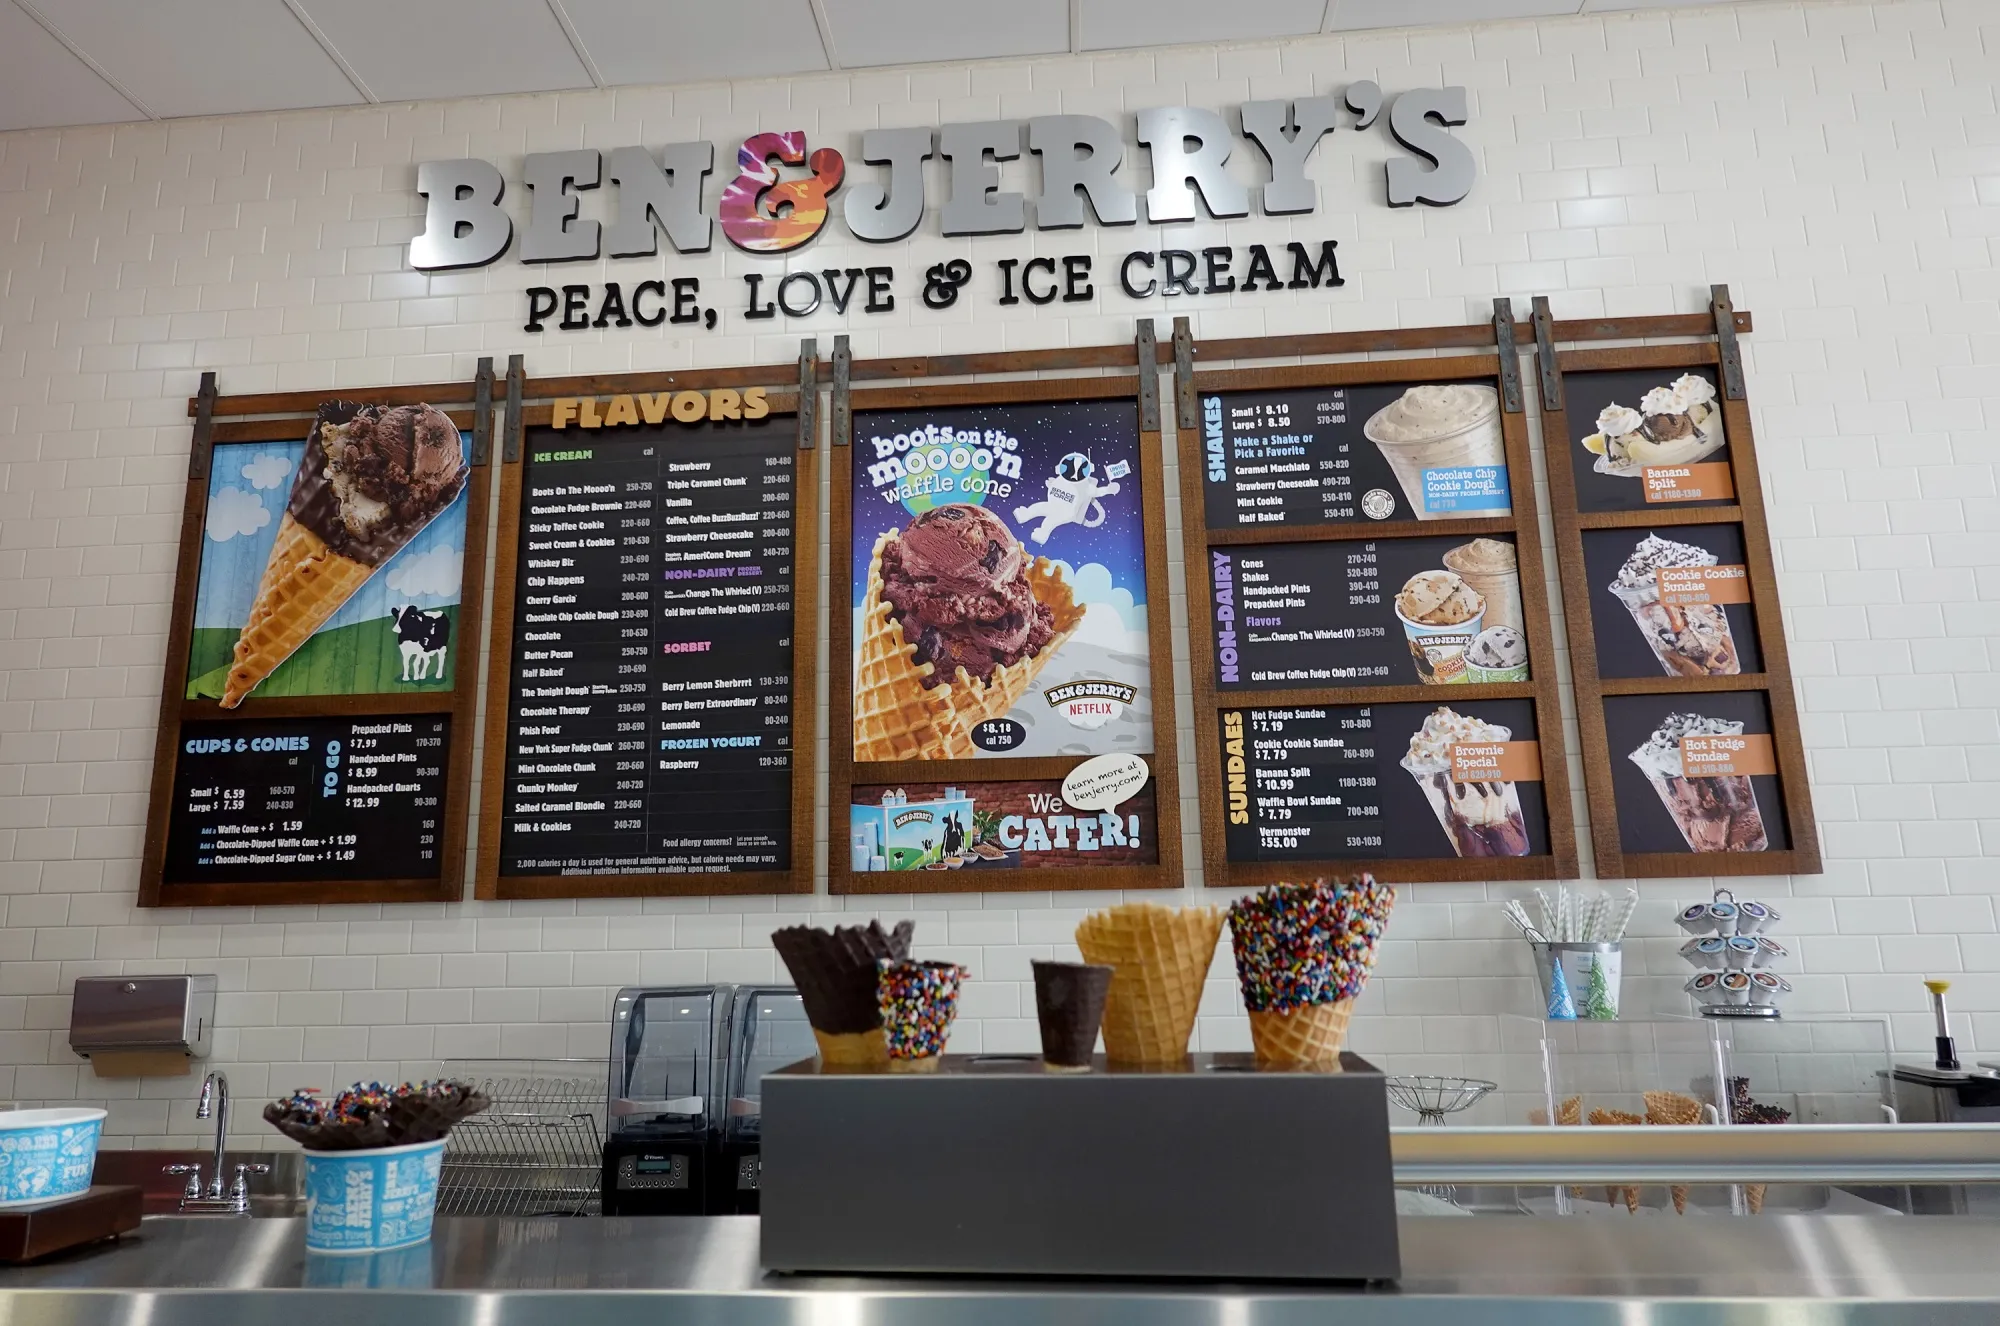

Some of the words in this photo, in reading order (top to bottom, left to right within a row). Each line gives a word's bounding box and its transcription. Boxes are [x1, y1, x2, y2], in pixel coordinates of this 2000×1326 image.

[524, 277, 717, 332] PEACE,
[744, 267, 895, 318] LOVE
[923, 258, 972, 309] &
[998, 255, 1093, 305] ICE
[1120, 240, 1345, 299] CREAM
[552, 387, 770, 429] FLAVORS
[1316, 402, 1345, 412] 410-500
[871, 423, 954, 459] boots
[956, 429, 981, 445] on
[983, 429, 1019, 451] the
[1203, 396, 1227, 483] SHAKES
[1233, 436, 1260, 447] Make
[1262, 438, 1269, 446] a
[1270, 434, 1301, 446] Shake
[1302, 434, 1313, 443] or
[534, 452, 552, 462] ICE
[553, 450, 593, 461] CREAM
[1234, 447, 1256, 459] Pick
[1257, 449, 1263, 458] a
[1265, 445, 1305, 457] Favorite
[669, 461, 711, 472] Strawberry
[867, 446, 1023, 488] moooo'n
[1319, 459, 1350, 471] 550-820
[1426, 470, 1471, 482] Chocolate
[1473, 468, 1497, 481] Chip
[1647, 468, 1691, 479] Banana
[532, 487, 554, 497] Boots
[556, 487, 567, 495] On
[568, 485, 582, 495] The
[583, 483, 616, 494] Moooo'n
[626, 482, 653, 492] 250-750
[881, 474, 954, 505] waffle
[960, 476, 1012, 498] cone
[1235, 480, 1276, 492] Strawberry
[1277, 478, 1319, 489] Cheesecake
[1427, 480, 1462, 492] Cookie
[1464, 478, 1495, 491] Dough
[1649, 479, 1677, 491] Split
[1050, 491, 1074, 503] FORCE
[1051, 487, 1076, 499] SPACE
[666, 498, 693, 508] Vanilla
[1237, 497, 1254, 507] Mint
[1255, 495, 1283, 506] Cookie
[531, 504, 566, 515] Chocolate
[567, 503, 590, 514] Fudge
[591, 501, 623, 511] Brownie
[1238, 512, 1255, 523] Half
[1256, 511, 1285, 522] Baked
[529, 523, 552, 534] Sticky
[553, 521, 577, 531] Toffee
[578, 520, 605, 530] Cookie
[665, 532, 708, 544] Strawberry
[709, 530, 754, 541] Cheesecake
[529, 540, 553, 551] Sweet
[553, 540, 577, 549] Cream
[578, 539, 584, 548] &
[585, 537, 615, 547] Cookies
[1241, 559, 1264, 569] Cones
[1347, 554, 1377, 564] 270-740
[665, 567, 735, 580] NON-DAIRY
[1242, 572, 1269, 583] Shakes
[1661, 571, 1702, 581] Cookie
[1704, 568, 1745, 579] Cookie
[527, 576, 546, 587] Chip
[547, 574, 585, 586] Happens
[1243, 585, 1289, 596] Handpacked
[1290, 584, 1311, 594] Pints
[1663, 582, 1706, 592] Sundae
[1244, 599, 1283, 610] Prepacked
[1285, 598, 1305, 608] Pints
[526, 612, 558, 623] Chocolate
[559, 612, 573, 623] Chip
[574, 611, 596, 621] Cookie
[597, 610, 619, 620] Dough
[1212, 551, 1240, 683] NON-DAIRY
[1246, 616, 1282, 627] Flavors
[525, 631, 561, 642] Chocolate
[1271, 631, 1298, 642] Change
[1299, 630, 1314, 641] The
[1314, 629, 1343, 640] Whirled
[1343, 628, 1355, 639] (V)
[664, 641, 712, 654] SORBET
[524, 650, 548, 660] Butter
[550, 650, 573, 659] Pecan
[523, 668, 538, 678] Half
[539, 667, 564, 677] Baked
[1069, 702, 1112, 716] NETFLIX
[1251, 710, 1266, 720] Hot
[1268, 710, 1293, 721] Fudge
[1295, 708, 1326, 719] Sundae
[352, 724, 392, 735] Prepacked
[393, 723, 412, 733] Pints
[661, 720, 701, 730] Lemonade
[1341, 719, 1372, 730] 510-880
[185, 739, 231, 754] CUPS
[234, 738, 248, 753] &
[251, 736, 310, 751] CONES
[416, 737, 441, 747] 170-370
[661, 738, 709, 750] FROZEN
[711, 736, 762, 748] YOGURT
[986, 736, 996, 745] cal
[997, 735, 1012, 745] 750
[1253, 739, 1282, 749] Cookie
[1283, 738, 1311, 748] Cookie
[1312, 737, 1344, 748] Sundae
[1685, 740, 1708, 750] Hot
[1710, 739, 1745, 751] Fudge
[326, 740, 341, 769] GO
[1455, 745, 1505, 756] Brownie
[1687, 751, 1730, 762] Sundae
[349, 754, 395, 764] Handpacked
[397, 752, 417, 763] Pints
[1456, 756, 1498, 770] Special
[660, 759, 699, 770] Raspberry
[1224, 711, 1249, 825] SUNDAES
[1066, 776, 1095, 791] learn
[1097, 767, 1124, 780] more
[1127, 761, 1137, 772] at
[1255, 768, 1289, 778] Banana
[1291, 767, 1311, 779] Split
[323, 771, 339, 797] TO
[347, 783, 393, 794] Handpacked
[395, 782, 421, 793] Quarts
[1073, 771, 1143, 802] benjerry.com!
[1027, 793, 1063, 814] We
[1257, 796, 1285, 807] Waffle
[1287, 796, 1309, 806] Bowl
[1310, 795, 1342, 806] Sundae
[999, 814, 1140, 851] CATER!
[1259, 825, 1311, 837] Vermonster
[1346, 836, 1382, 847] 530-1030
